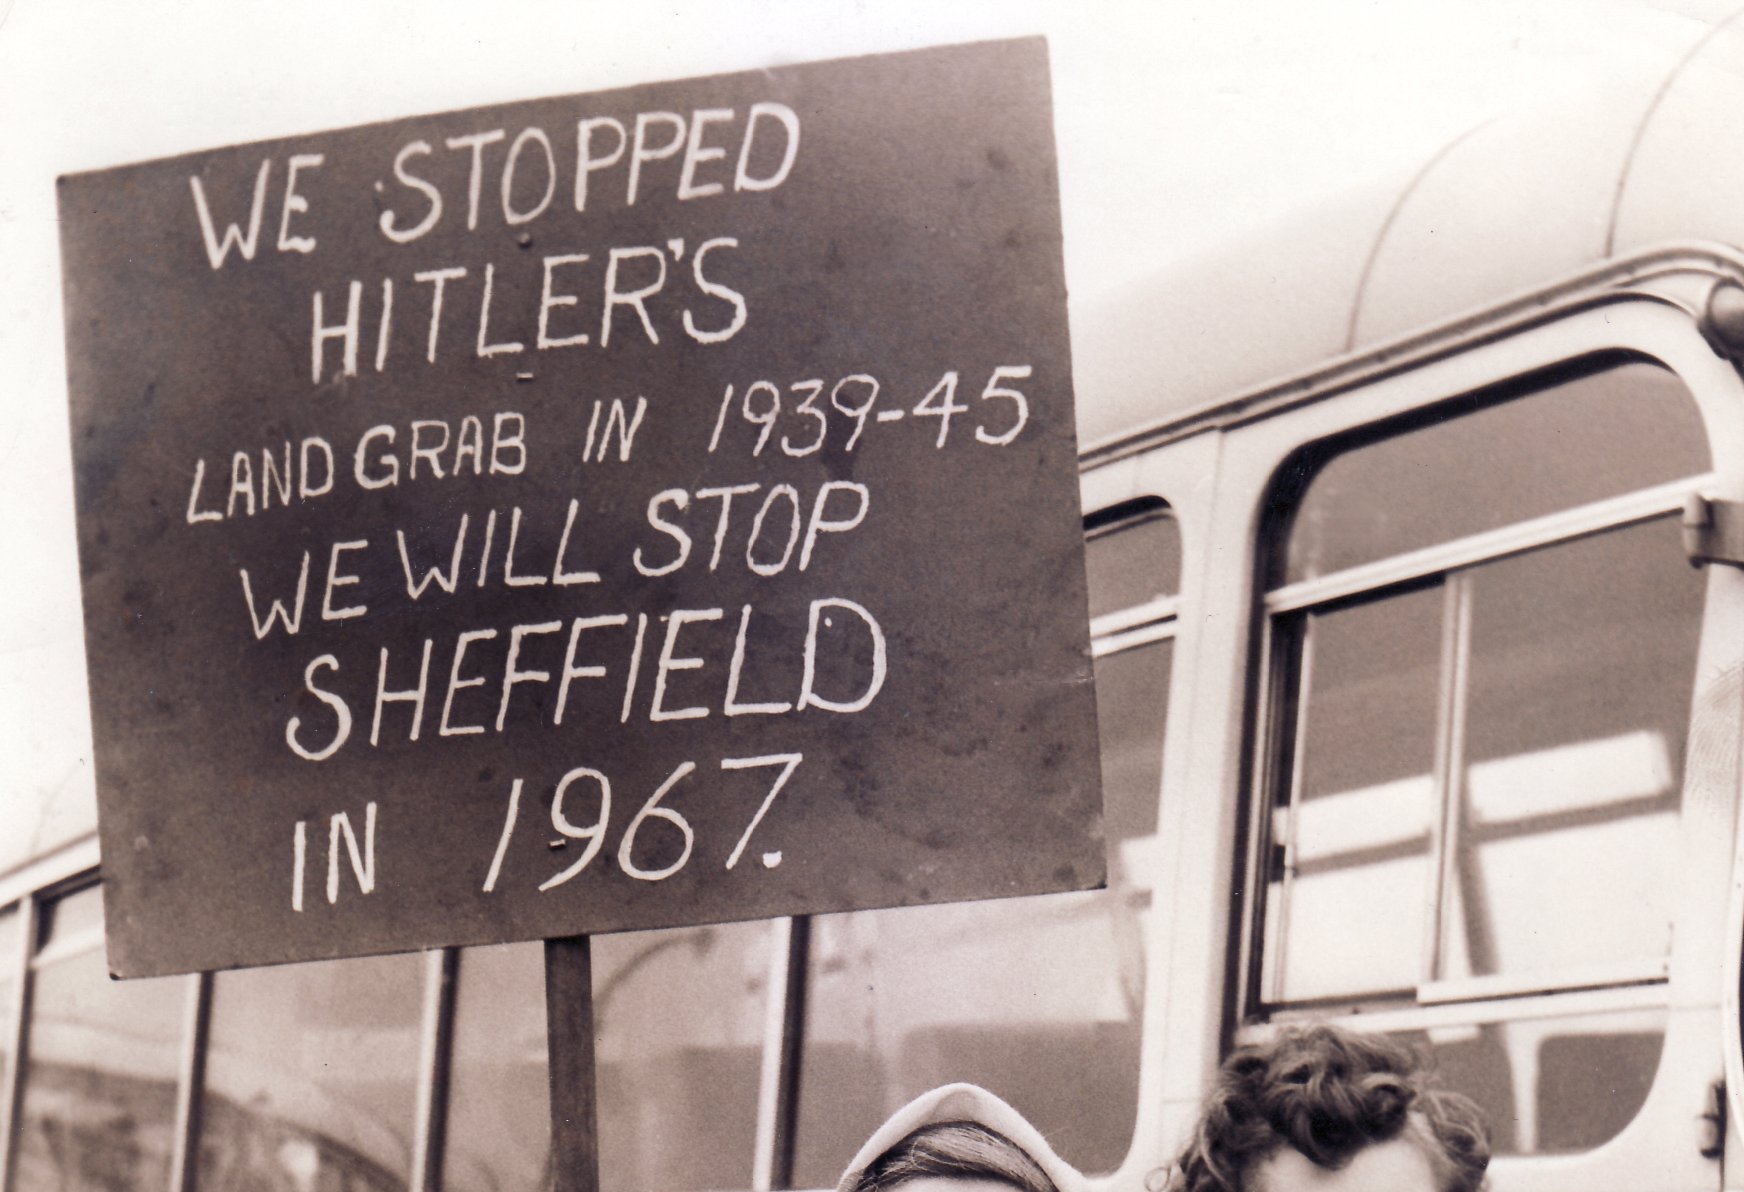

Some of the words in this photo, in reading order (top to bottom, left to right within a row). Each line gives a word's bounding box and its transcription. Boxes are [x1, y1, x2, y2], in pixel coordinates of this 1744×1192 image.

[189, 154, 324, 269] WE
[380, 103, 800, 244] STOPPED
[311, 236, 748, 384] HITLER'S
[186, 436, 335, 525] LAND
[353, 411, 527, 490] GRAB
[582, 395, 648, 463] IN
[707, 364, 1033, 458] 1939-45
[239, 538, 369, 640] WE
[396, 498, 602, 601] WILL
[632, 480, 870, 577] STOP
[285, 596, 888, 762] SHEFFIELD
[291, 801, 378, 912] IN
[482, 752, 804, 893] 1967.
